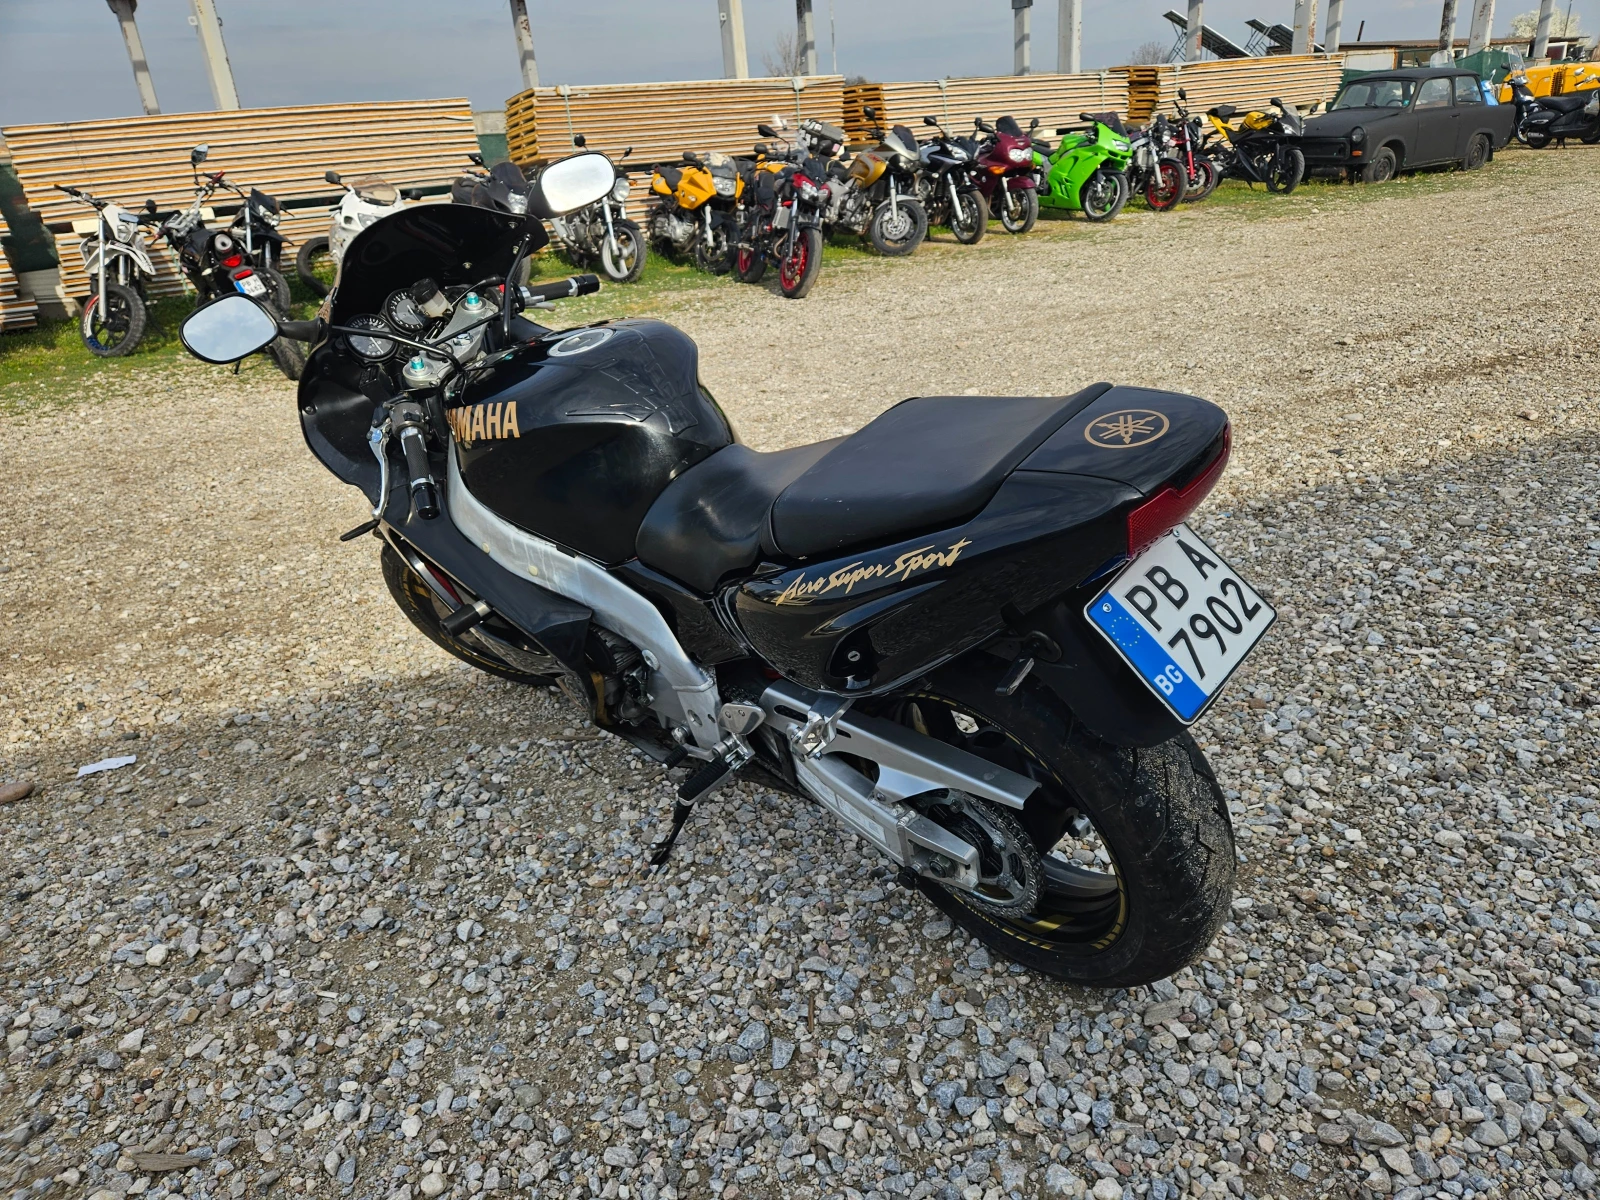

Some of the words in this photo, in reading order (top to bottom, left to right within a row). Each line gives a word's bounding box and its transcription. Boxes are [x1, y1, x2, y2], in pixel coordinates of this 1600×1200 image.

[776, 572, 826, 606] Aero
[820, 561, 891, 594] Super
[885, 537, 972, 581] Sport
[1124, 565, 1189, 632] PB
[1176, 539, 1218, 580] A
[1167, 577, 1262, 680] 7902
[1154, 664, 1184, 696] BG
